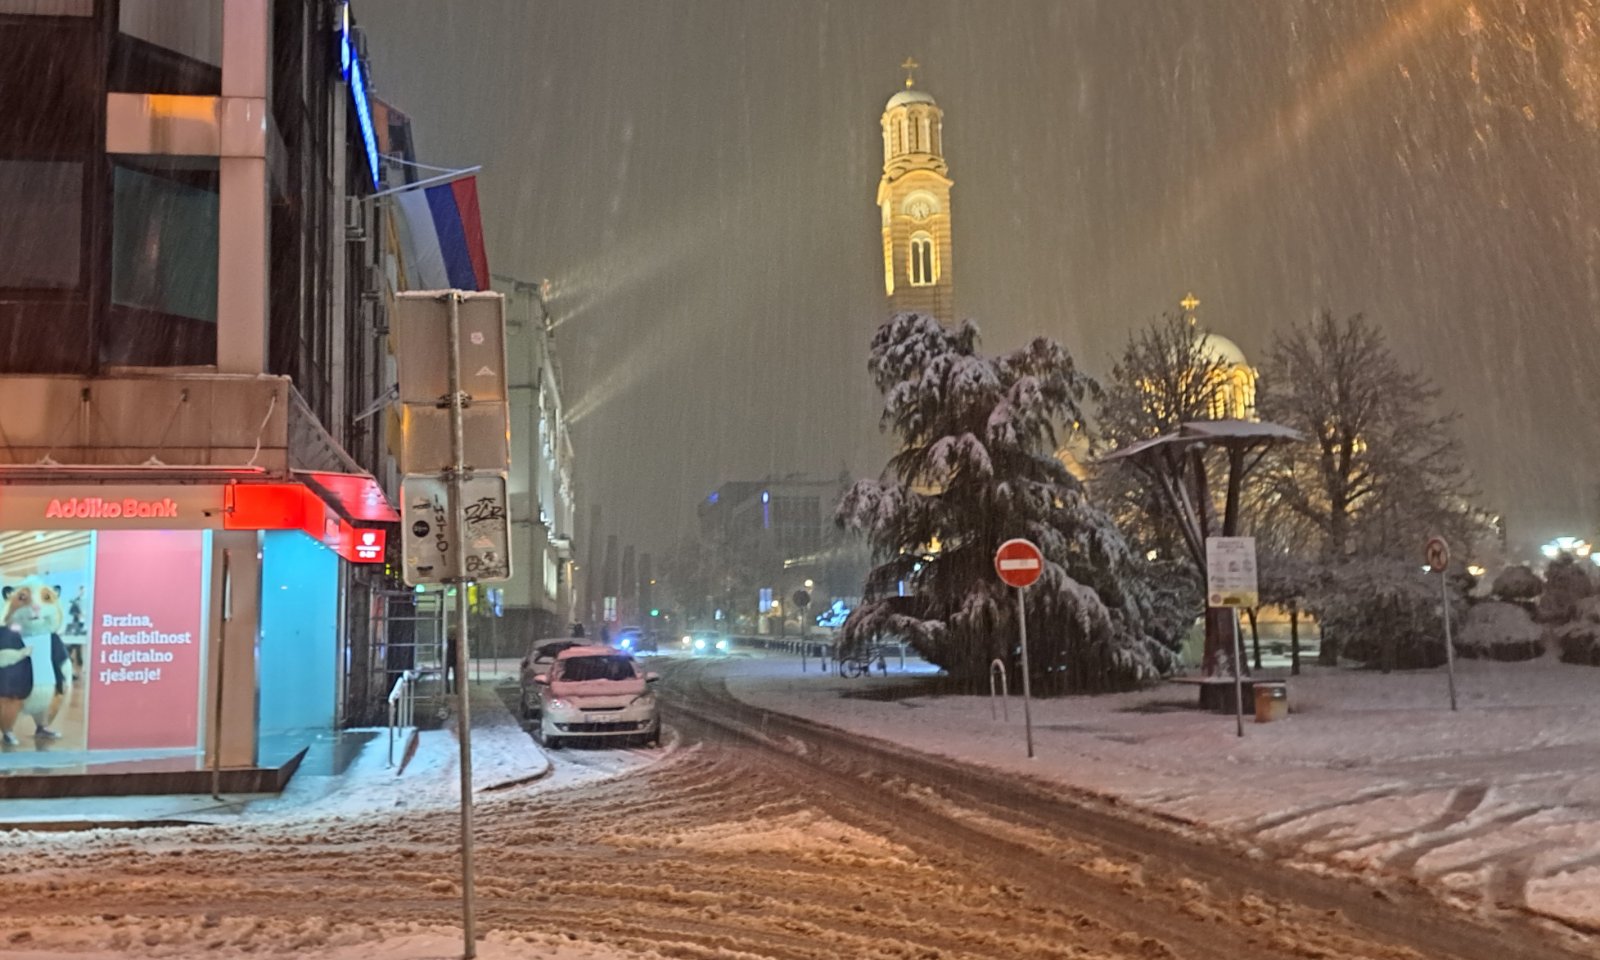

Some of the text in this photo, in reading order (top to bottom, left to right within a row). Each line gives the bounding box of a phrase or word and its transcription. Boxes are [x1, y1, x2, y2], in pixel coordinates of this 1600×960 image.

[46, 497, 177, 518] Addiko Bank
[102, 613, 153, 628] Brzina,
[102, 631, 192, 645] fleksibilnost
[101, 648, 173, 667] i digitalno
[100, 668, 161, 685] rješenje!
